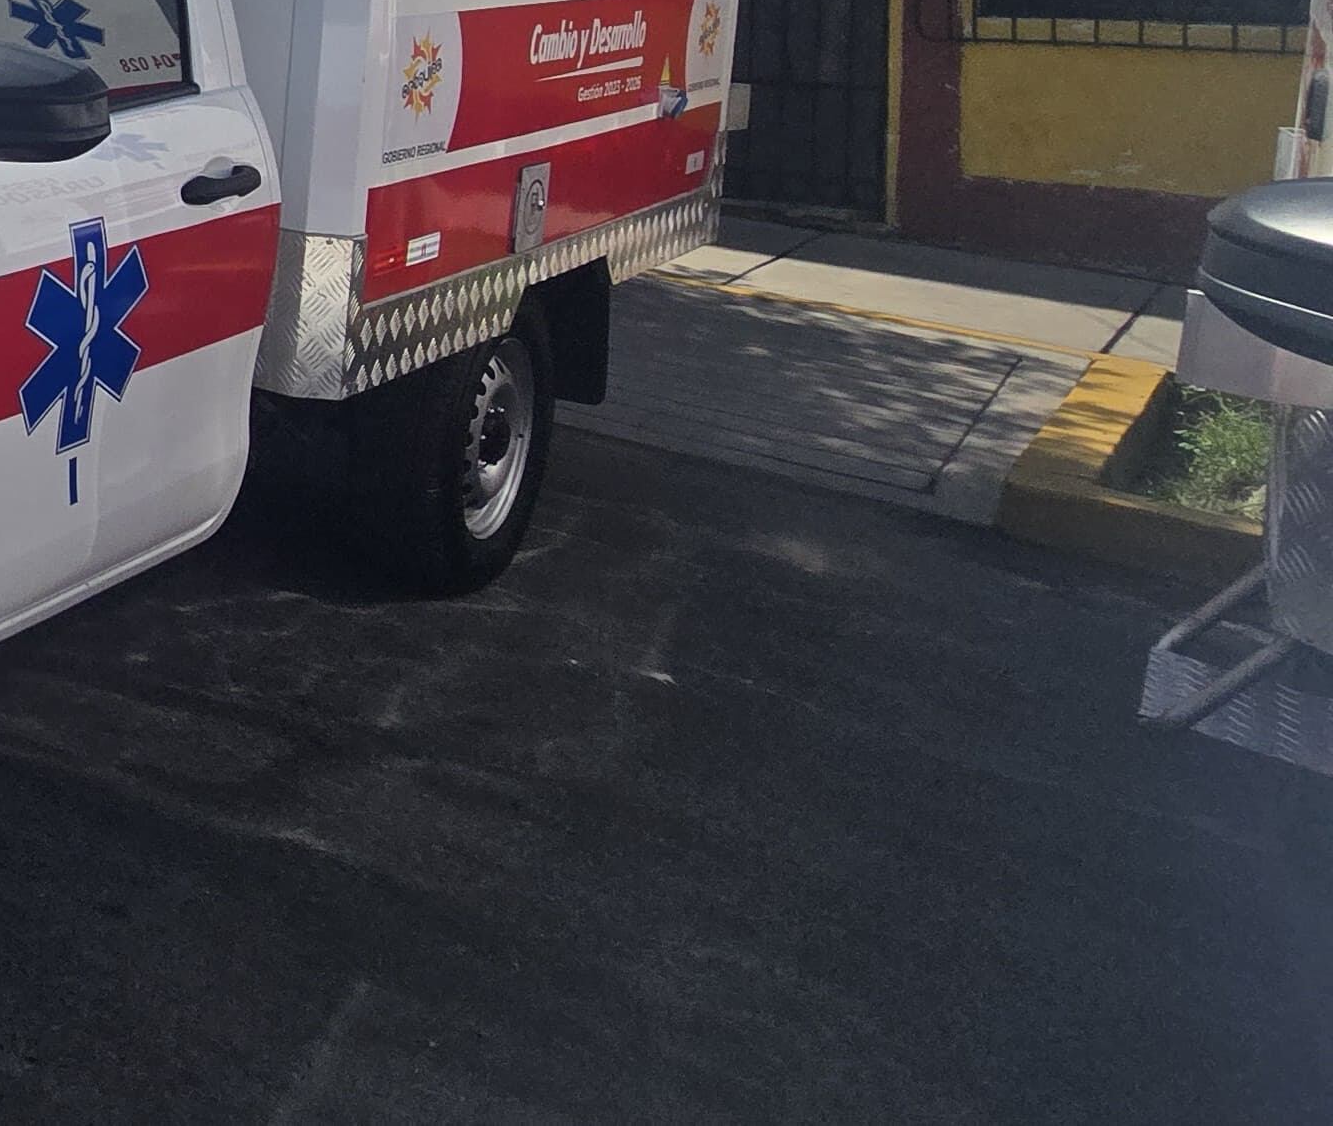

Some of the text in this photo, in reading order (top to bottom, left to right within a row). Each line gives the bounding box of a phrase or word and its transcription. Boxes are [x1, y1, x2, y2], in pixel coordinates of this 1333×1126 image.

[530, 19, 578, 65] Cambio
[576, 28, 590, 69] y
[589, 10, 647, 55] Desarrollo
[578, 83, 603, 102] Gestión
